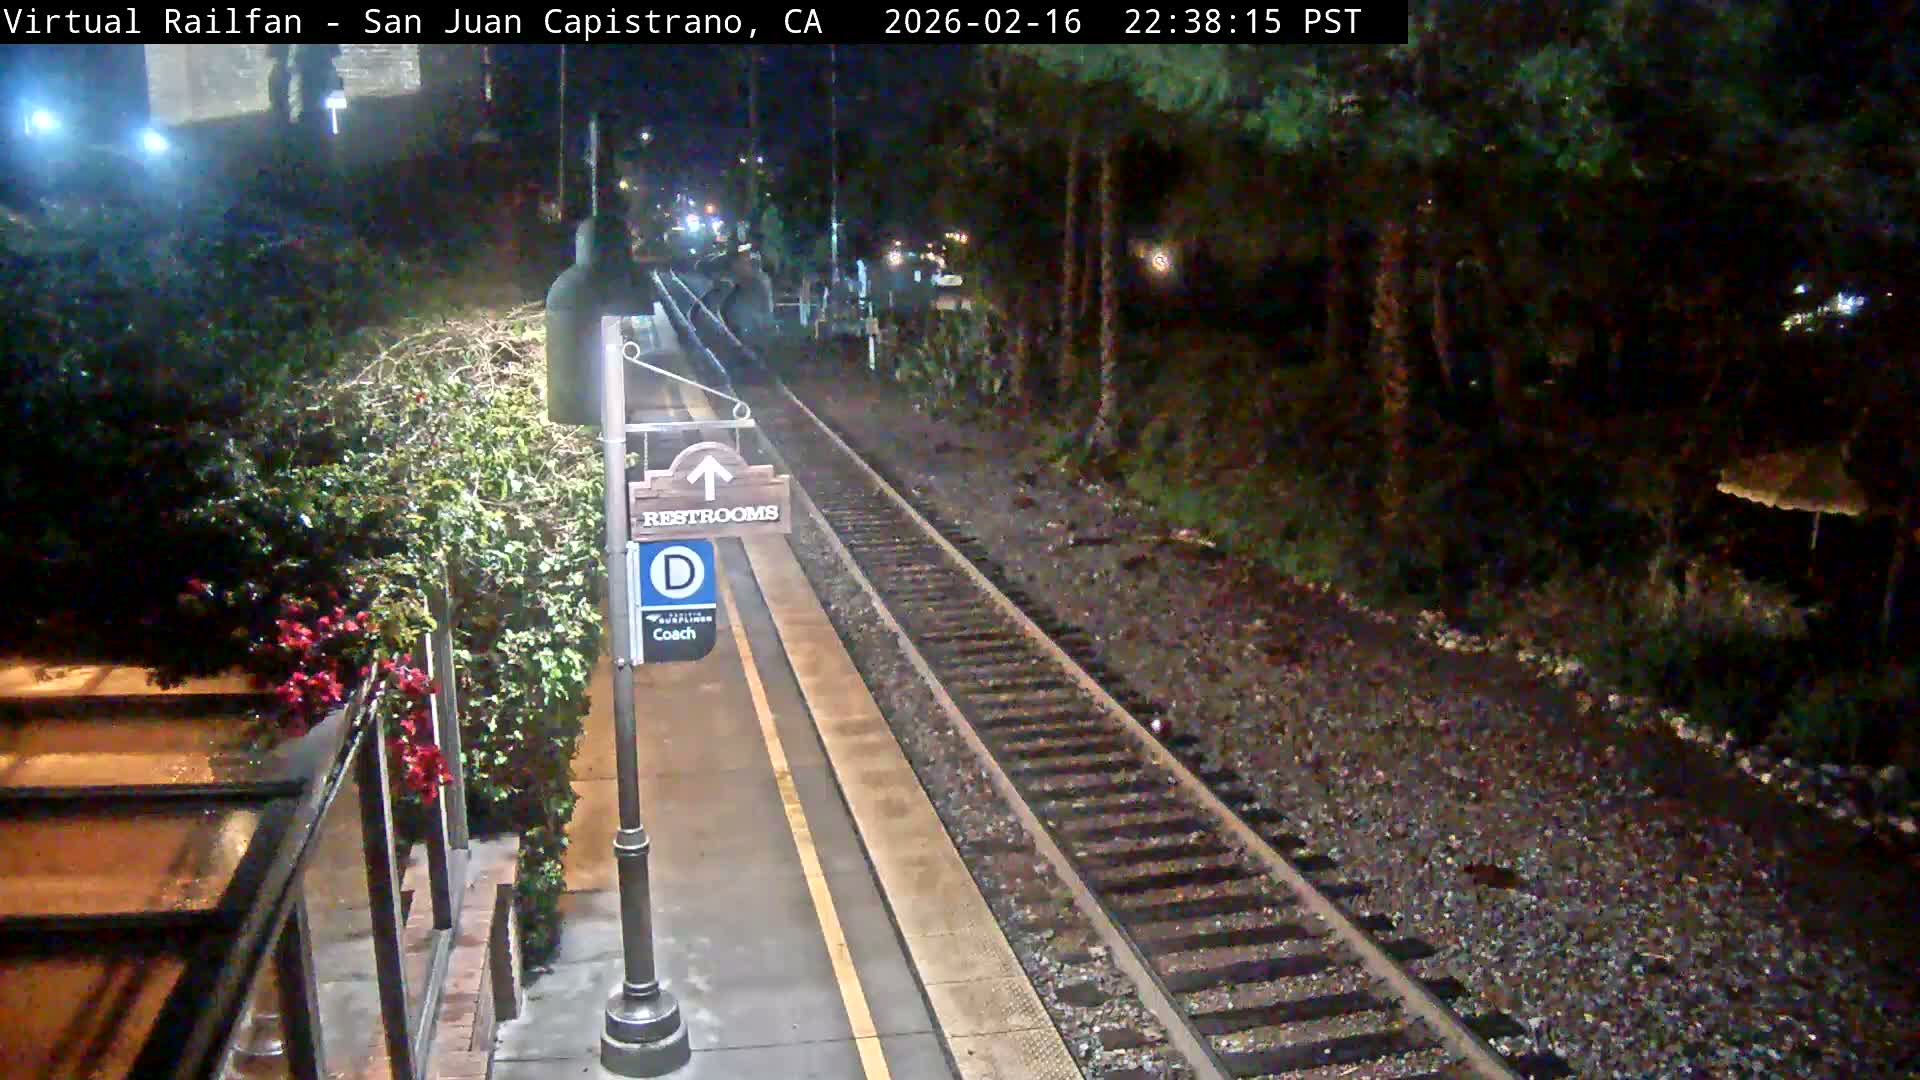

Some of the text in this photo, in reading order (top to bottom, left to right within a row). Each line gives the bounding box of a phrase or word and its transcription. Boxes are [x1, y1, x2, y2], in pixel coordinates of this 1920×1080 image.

[642, 505, 779, 527] RESTROOMS
[664, 554, 695, 590] D
[653, 626, 696, 641] Coach
